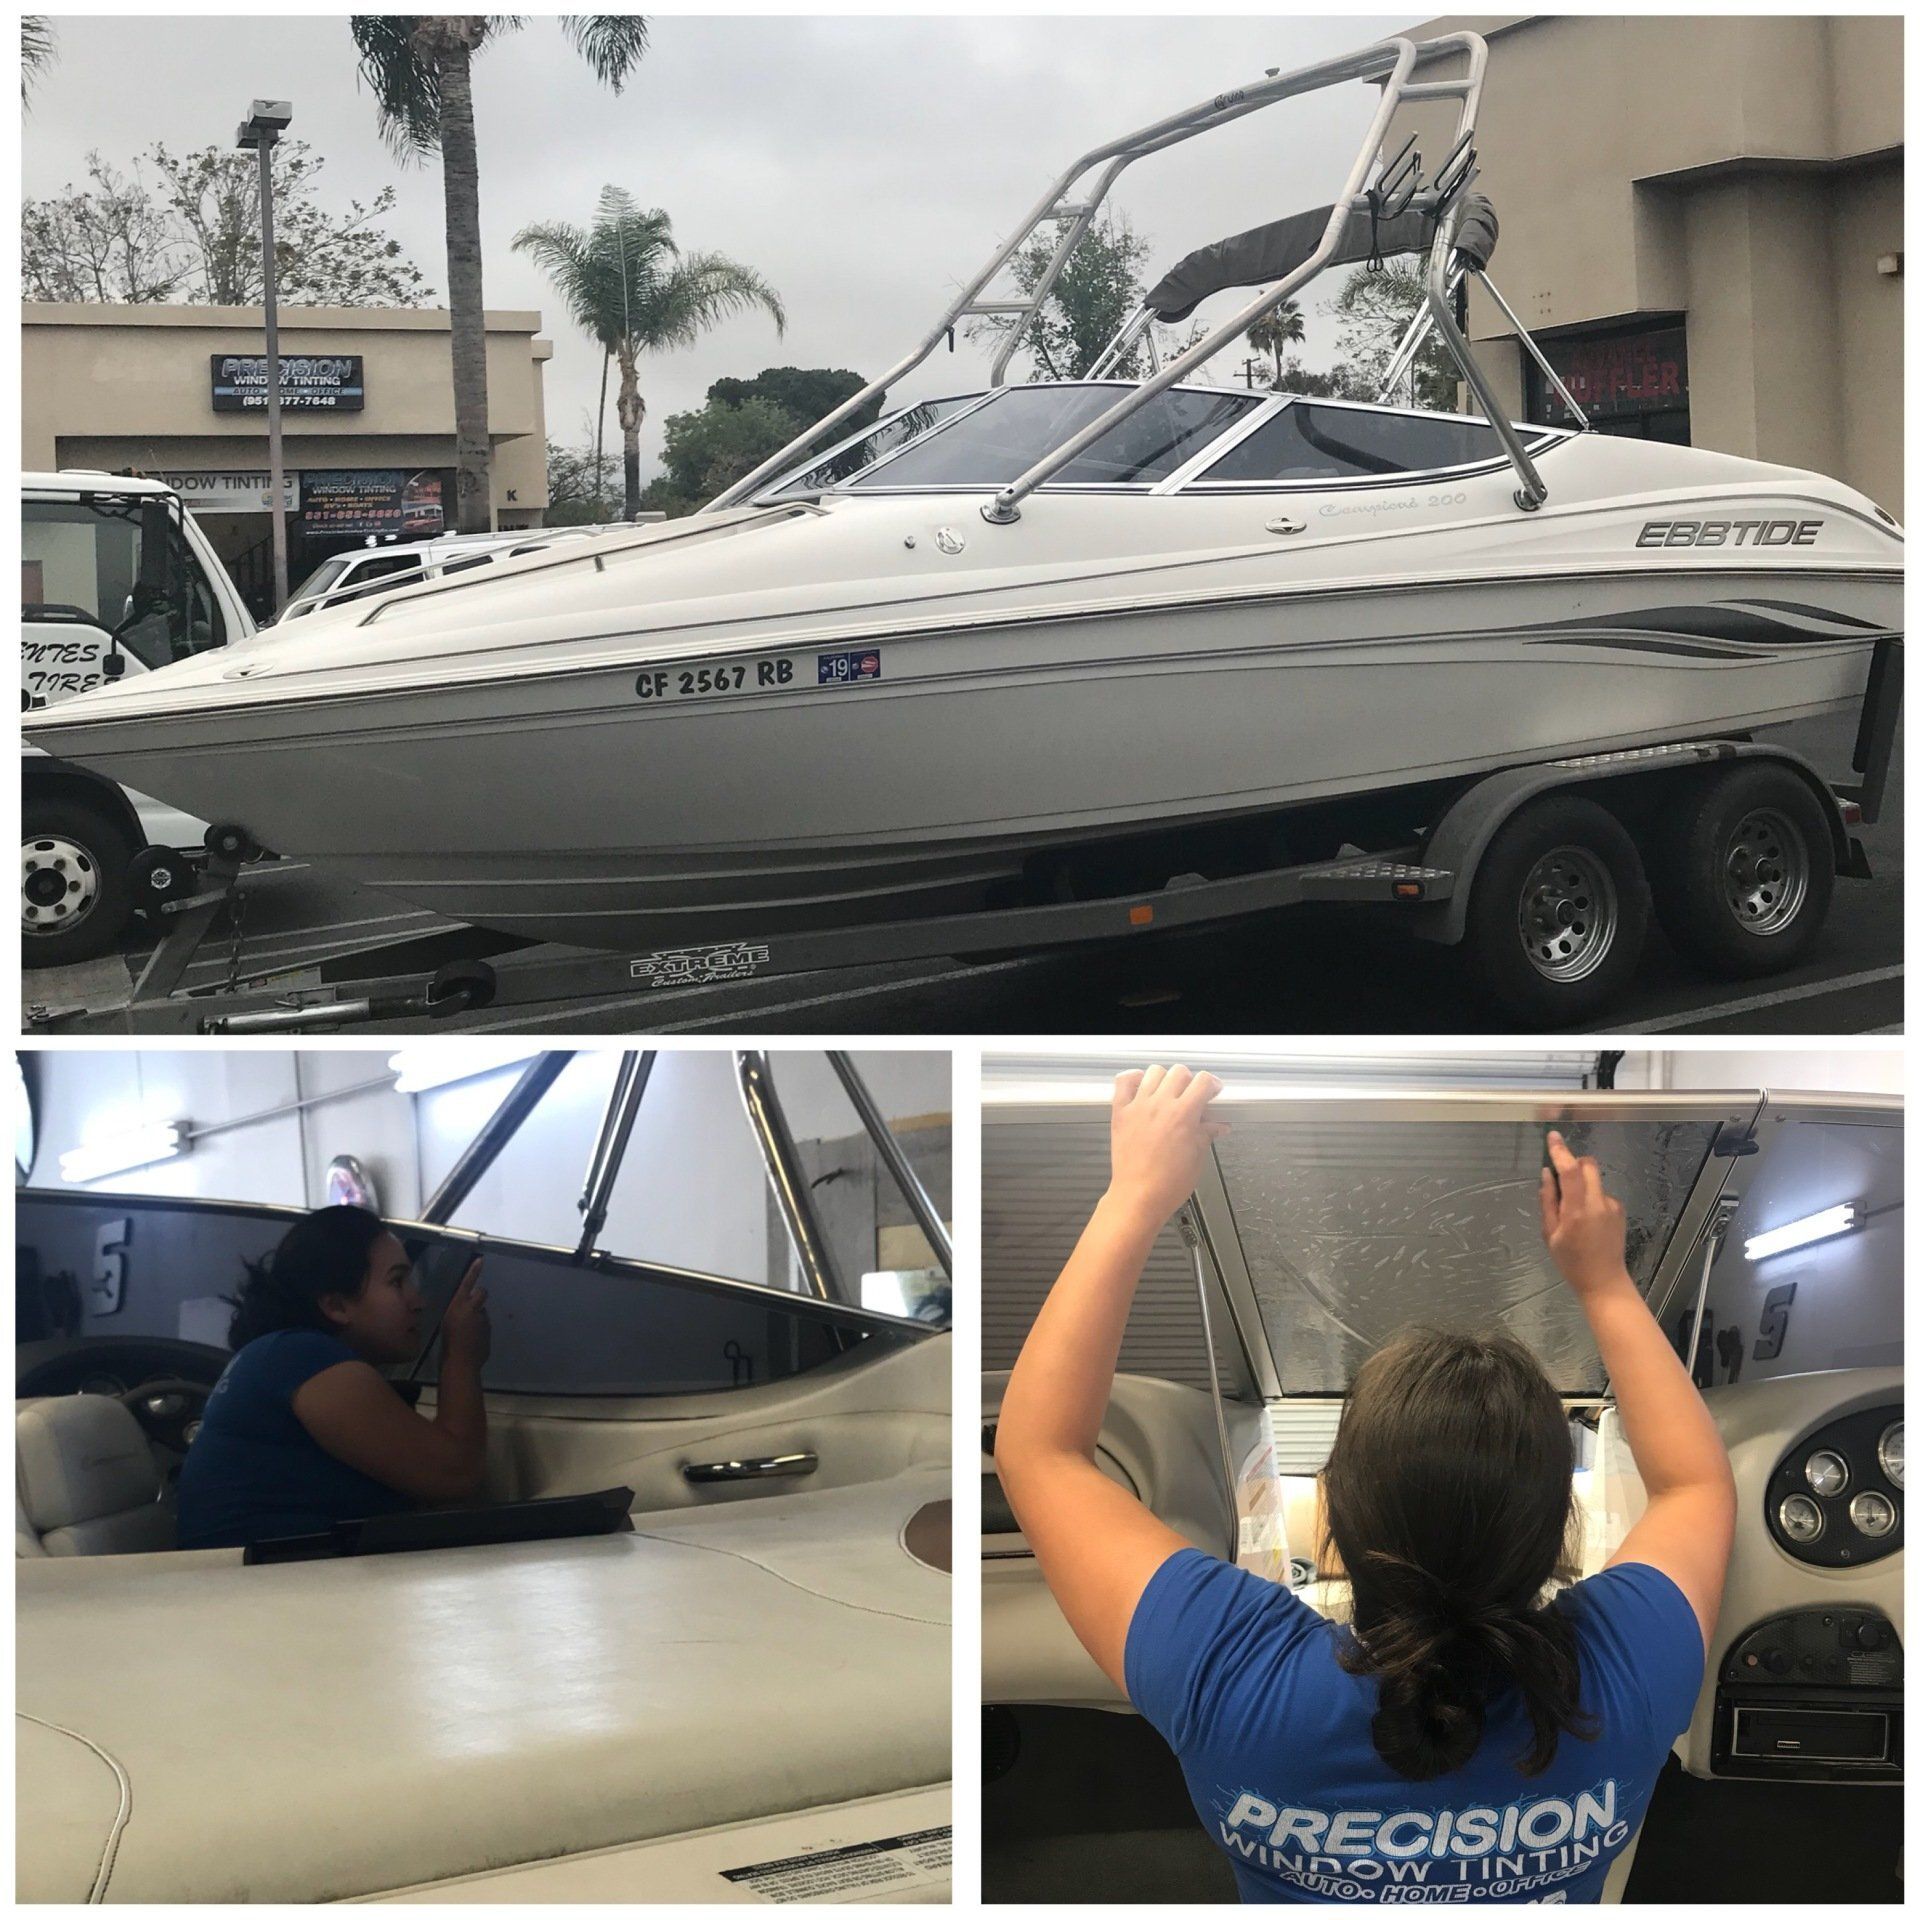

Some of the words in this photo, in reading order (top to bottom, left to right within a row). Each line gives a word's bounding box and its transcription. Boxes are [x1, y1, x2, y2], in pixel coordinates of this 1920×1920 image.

[222, 358, 352, 378] PRECISION
[234, 376, 289, 385] WINDW
[293, 376, 341, 386] TINTING
[233, 387, 260, 395] AUTO
[276, 387, 300, 395] OME
[311, 387, 345, 395] OFFICE
[243, 396, 269, 406] (951
[157, 476, 216, 490] NDOW
[312, 485, 355, 494] WINDOW
[358, 485, 396, 494] TINTING
[506, 488, 518, 501] K
[1428, 493, 1467, 507] 200
[1635, 520, 1825, 548] EBBTIDE
[829, 659, 848, 677] 19
[635, 673, 668, 698] CF
[678, 667, 746, 695] 2567
[757, 659, 793, 686] RB
[630, 949, 770, 978] EXTREME
[651, 976, 699, 987] Custom
[699, 969, 754, 984] Trailers
[1228, 1780, 1616, 1858] PRECISION
[1219, 1821, 1434, 1883] WINDOW
[1449, 1820, 1629, 1881] TINTING
[1280, 1869, 1363, 1901] AUTO
[1379, 1884, 1471, 1904] HOME
[1488, 1860, 1592, 1898] OFFICE
